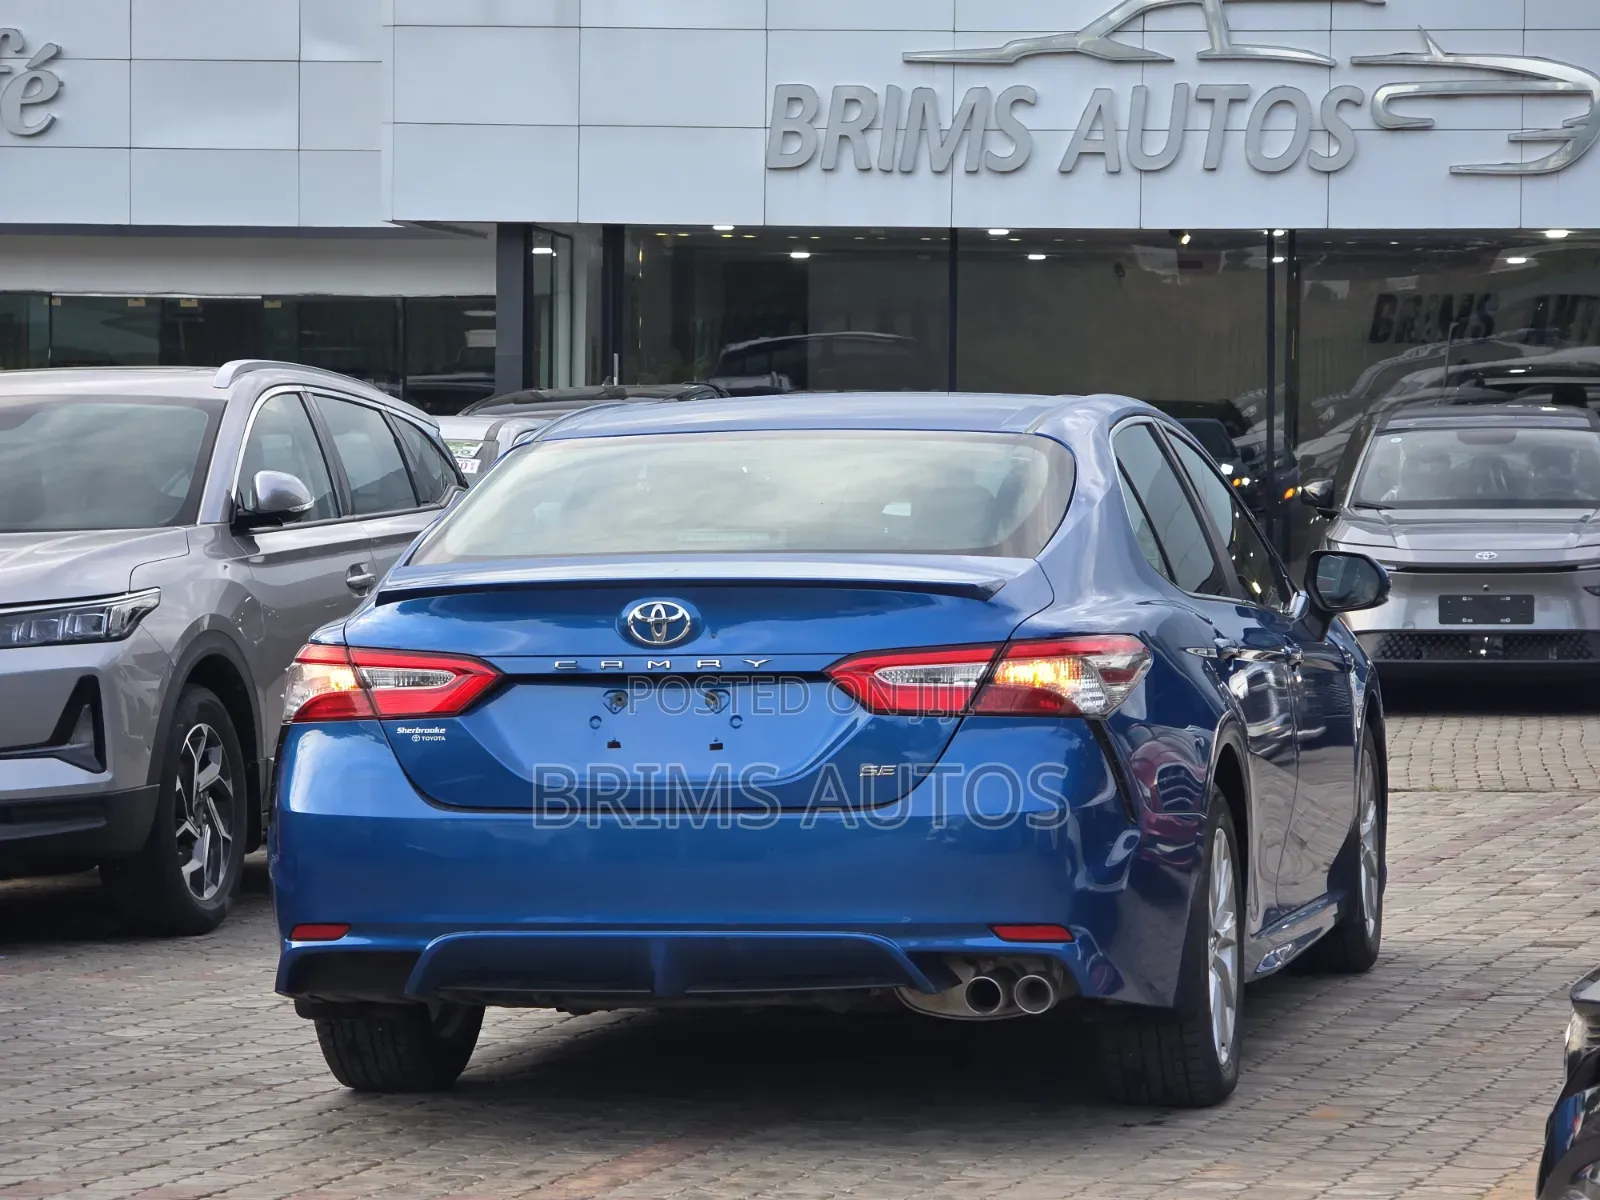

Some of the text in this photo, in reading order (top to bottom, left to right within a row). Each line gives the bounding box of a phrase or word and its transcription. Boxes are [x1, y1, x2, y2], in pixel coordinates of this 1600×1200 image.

[767, 83, 1362, 172] BRIMS AUTOS
[554, 658, 772, 670] CAMRY
[860, 764, 897, 777] SE
